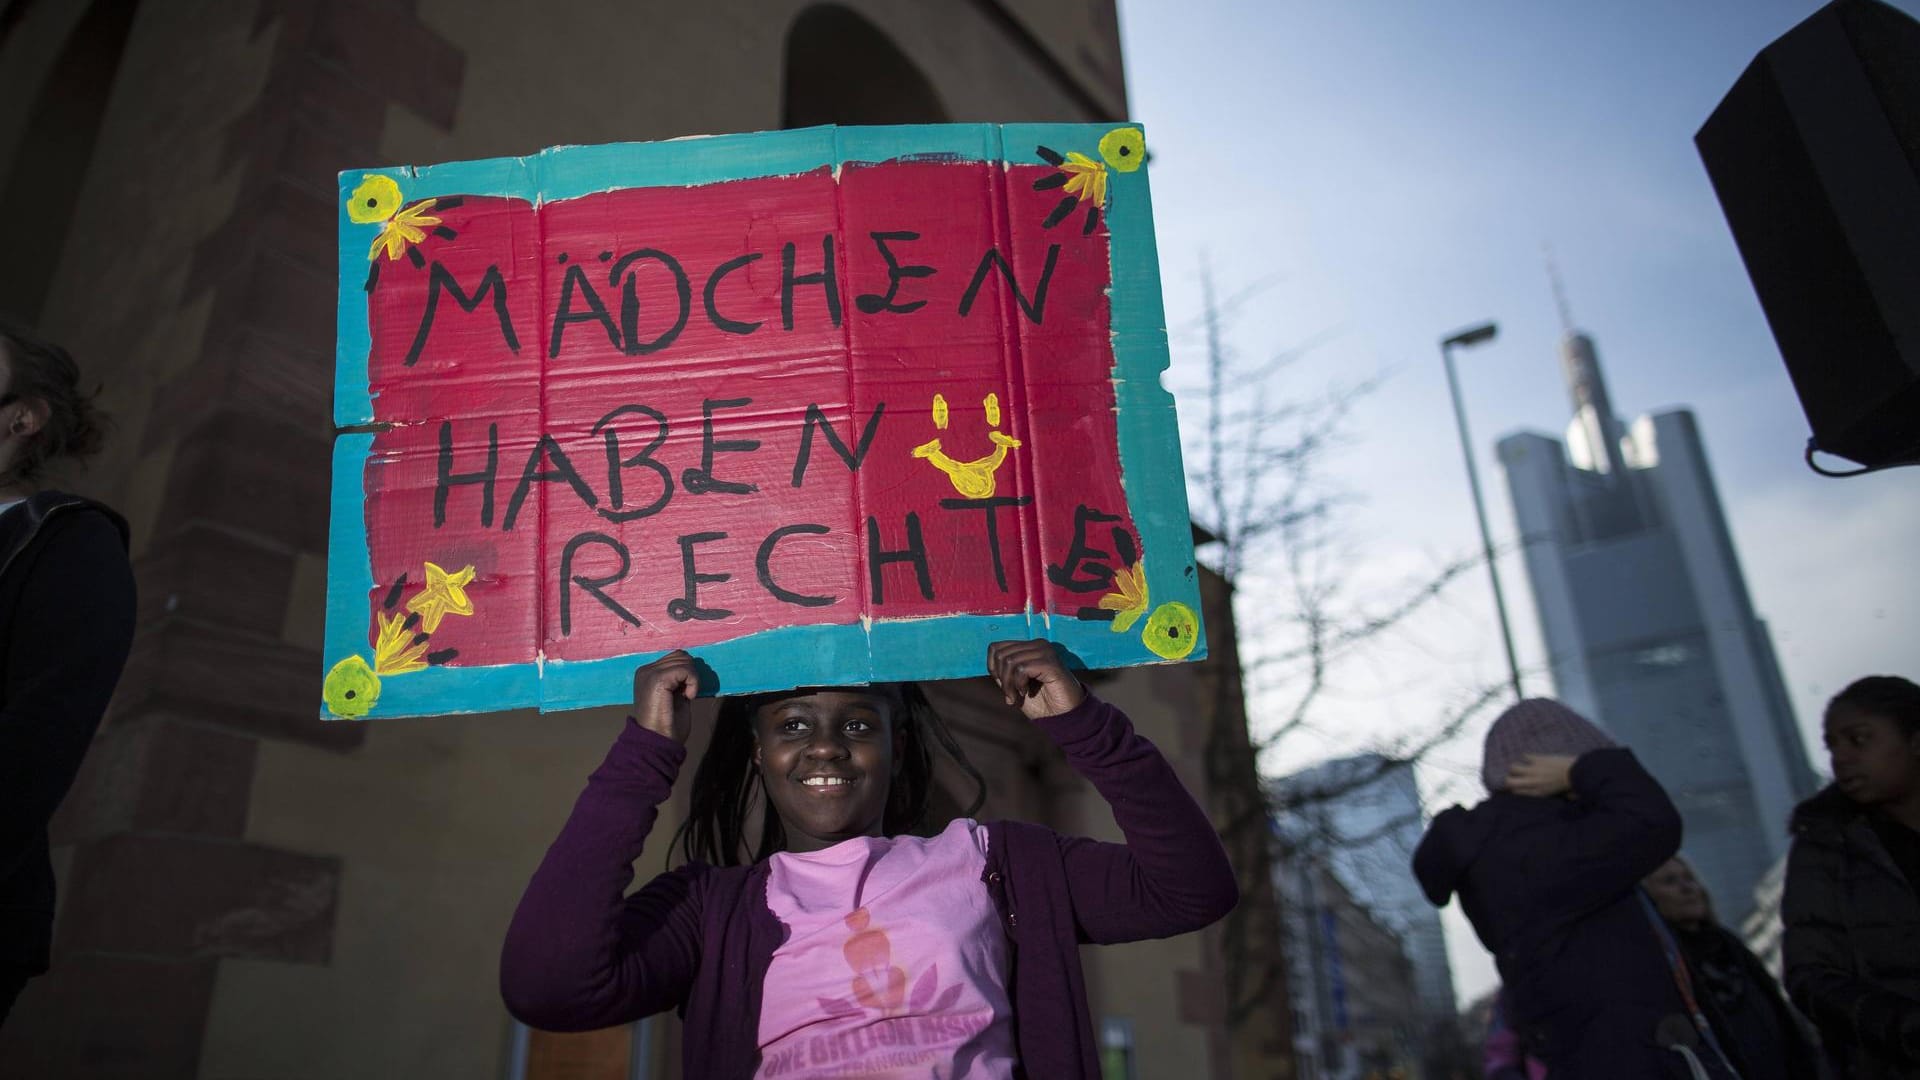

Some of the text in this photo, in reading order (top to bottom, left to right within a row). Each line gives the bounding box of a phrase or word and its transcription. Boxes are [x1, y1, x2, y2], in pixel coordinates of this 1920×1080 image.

[405, 231, 1061, 366] MÄDCHEN
[434, 398, 885, 530] HABEN
[561, 495, 1123, 634] RECHTE
[764, 1039, 805, 1078] ONE
